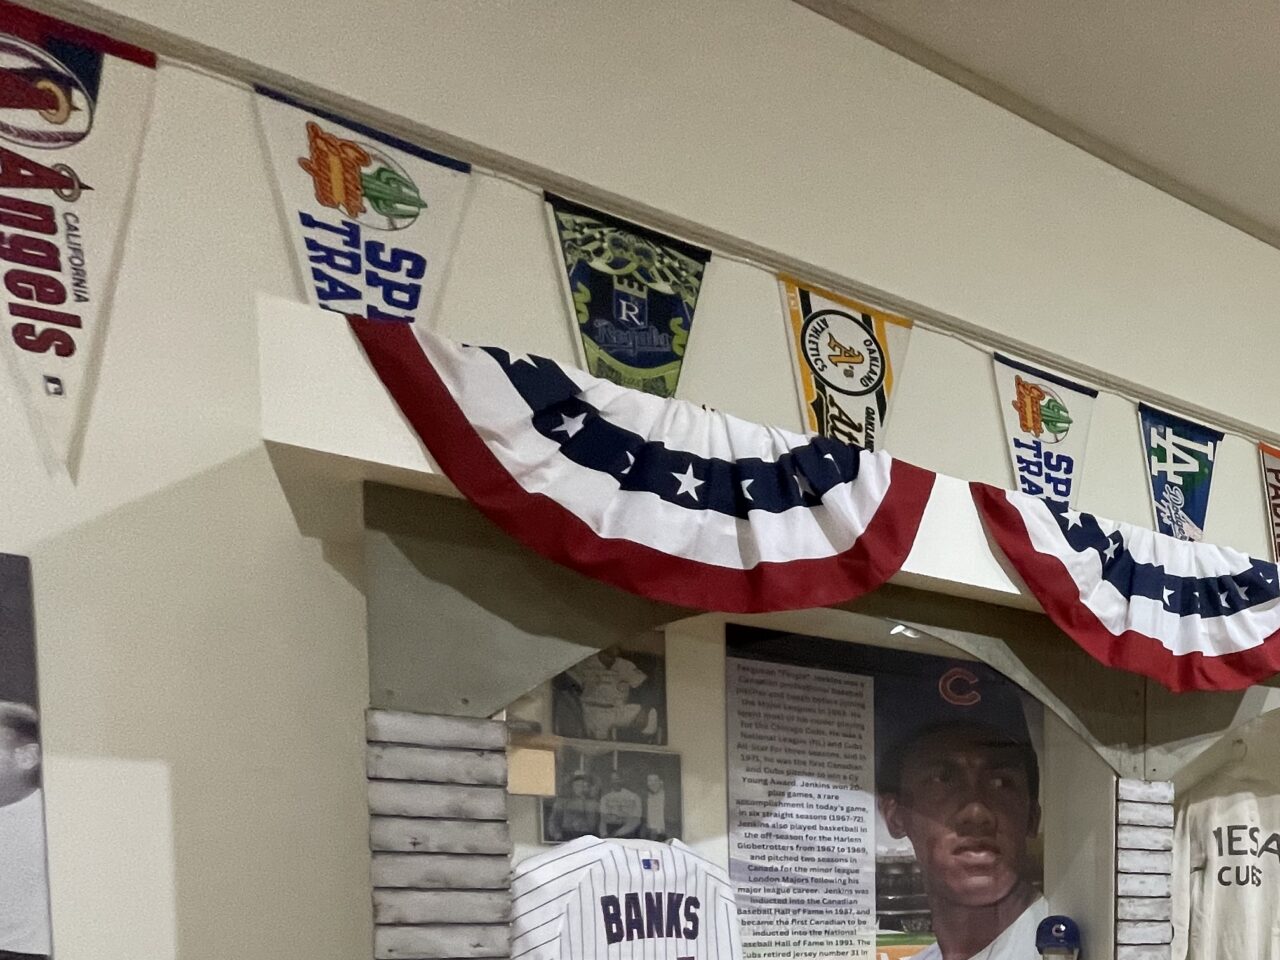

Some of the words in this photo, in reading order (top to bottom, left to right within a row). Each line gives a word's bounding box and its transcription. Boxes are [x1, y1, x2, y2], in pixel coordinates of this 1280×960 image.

[0, 148, 84, 358] Angels
[63, 211, 90, 303] CALIFORNIA
[364, 240, 427, 323] SP
[619, 299, 642, 326] R
[808, 317, 829, 372] ATHLETICS
[859, 338, 880, 388] OAKLAND
[1151, 426, 1214, 486] LA
[1043, 451, 1074, 505] SP
[815, 803, 843, 811] today's
[790, 823, 816, 831] played
[819, 824, 858, 832] basketball
[737, 841, 793, 851] Globetrotters
[767, 854, 798, 862] pitched
[747, 864, 778, 872] Canada
[834, 867, 859, 875] league
[782, 876, 808, 884] Majors
[811, 876, 846, 885] following
[737, 886, 761, 894] major
[763, 886, 790, 894] league
[600, 892, 700, 945] BANKS
[792, 950, 816, 958] jersey
